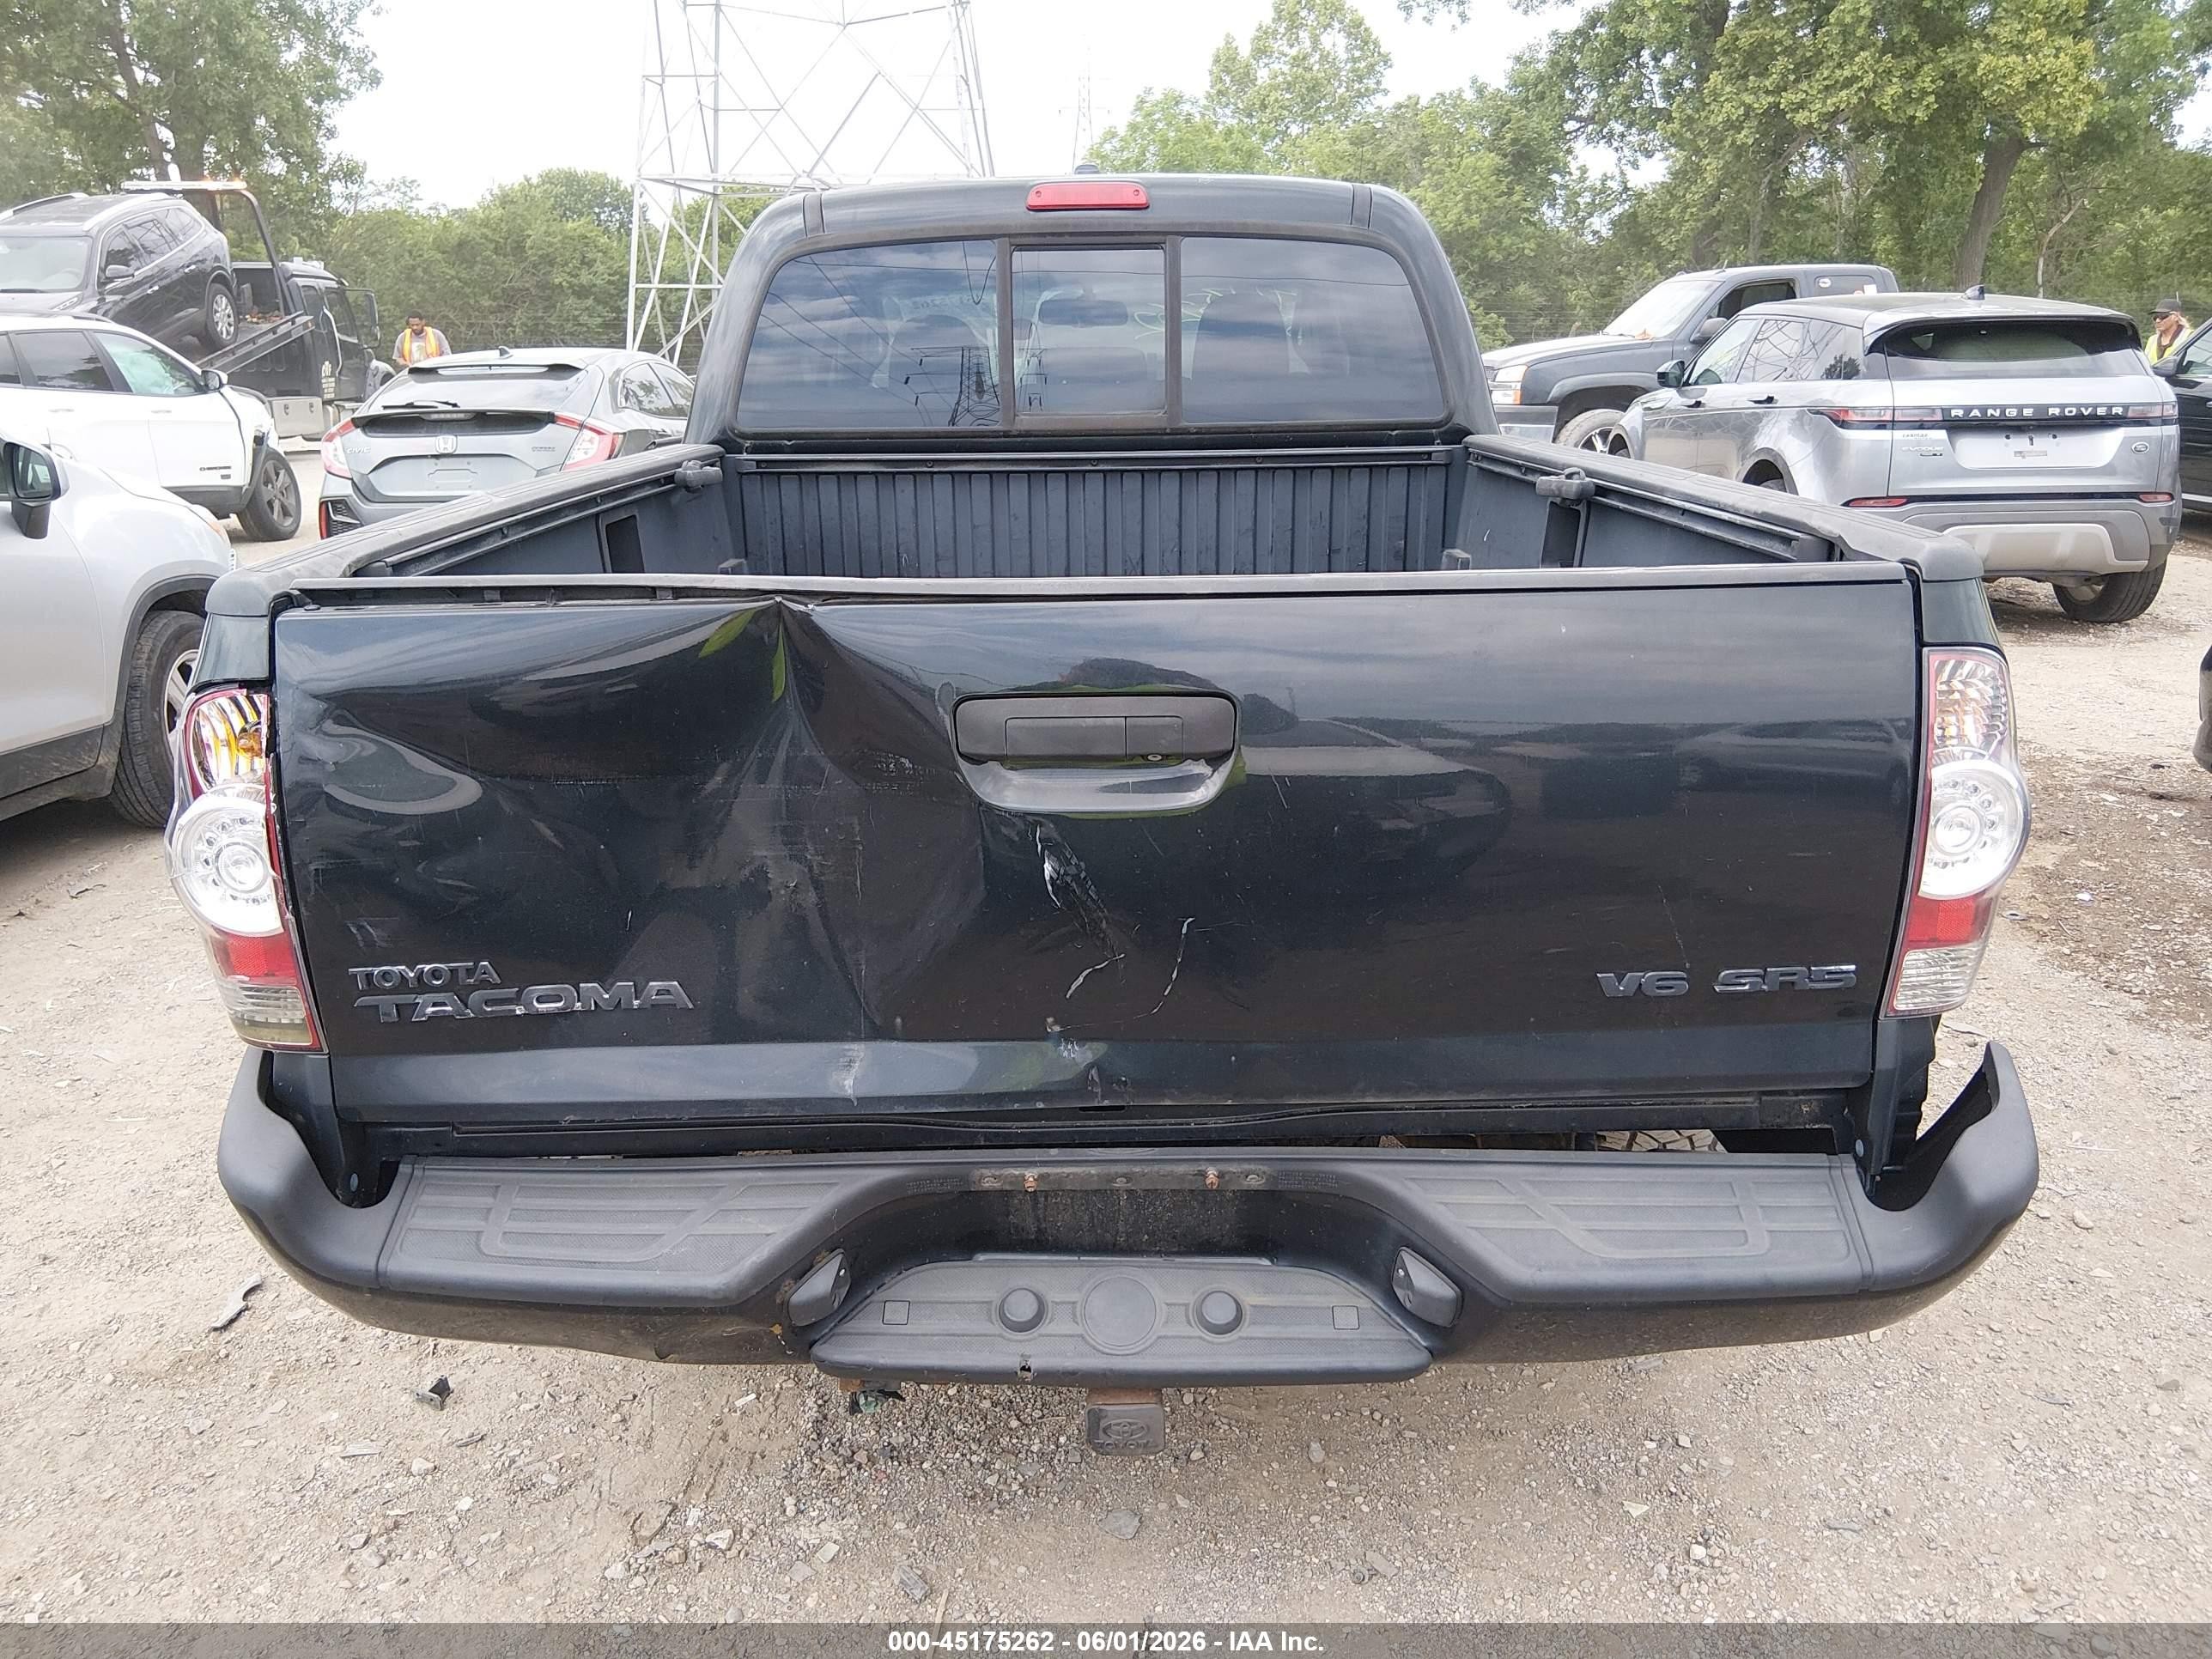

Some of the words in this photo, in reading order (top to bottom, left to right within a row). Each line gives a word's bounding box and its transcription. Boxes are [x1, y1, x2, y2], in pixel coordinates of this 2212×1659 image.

[1950, 407, 2034, 418] RANGE
[2048, 405, 2125, 416] ROVER
[346, 446, 371, 454] CIVIC
[349, 961, 501, 990] TOYOTA
[1596, 969, 1689, 998] V6
[1712, 963, 1856, 994] SR5
[354, 981, 695, 1023] TACOMA
